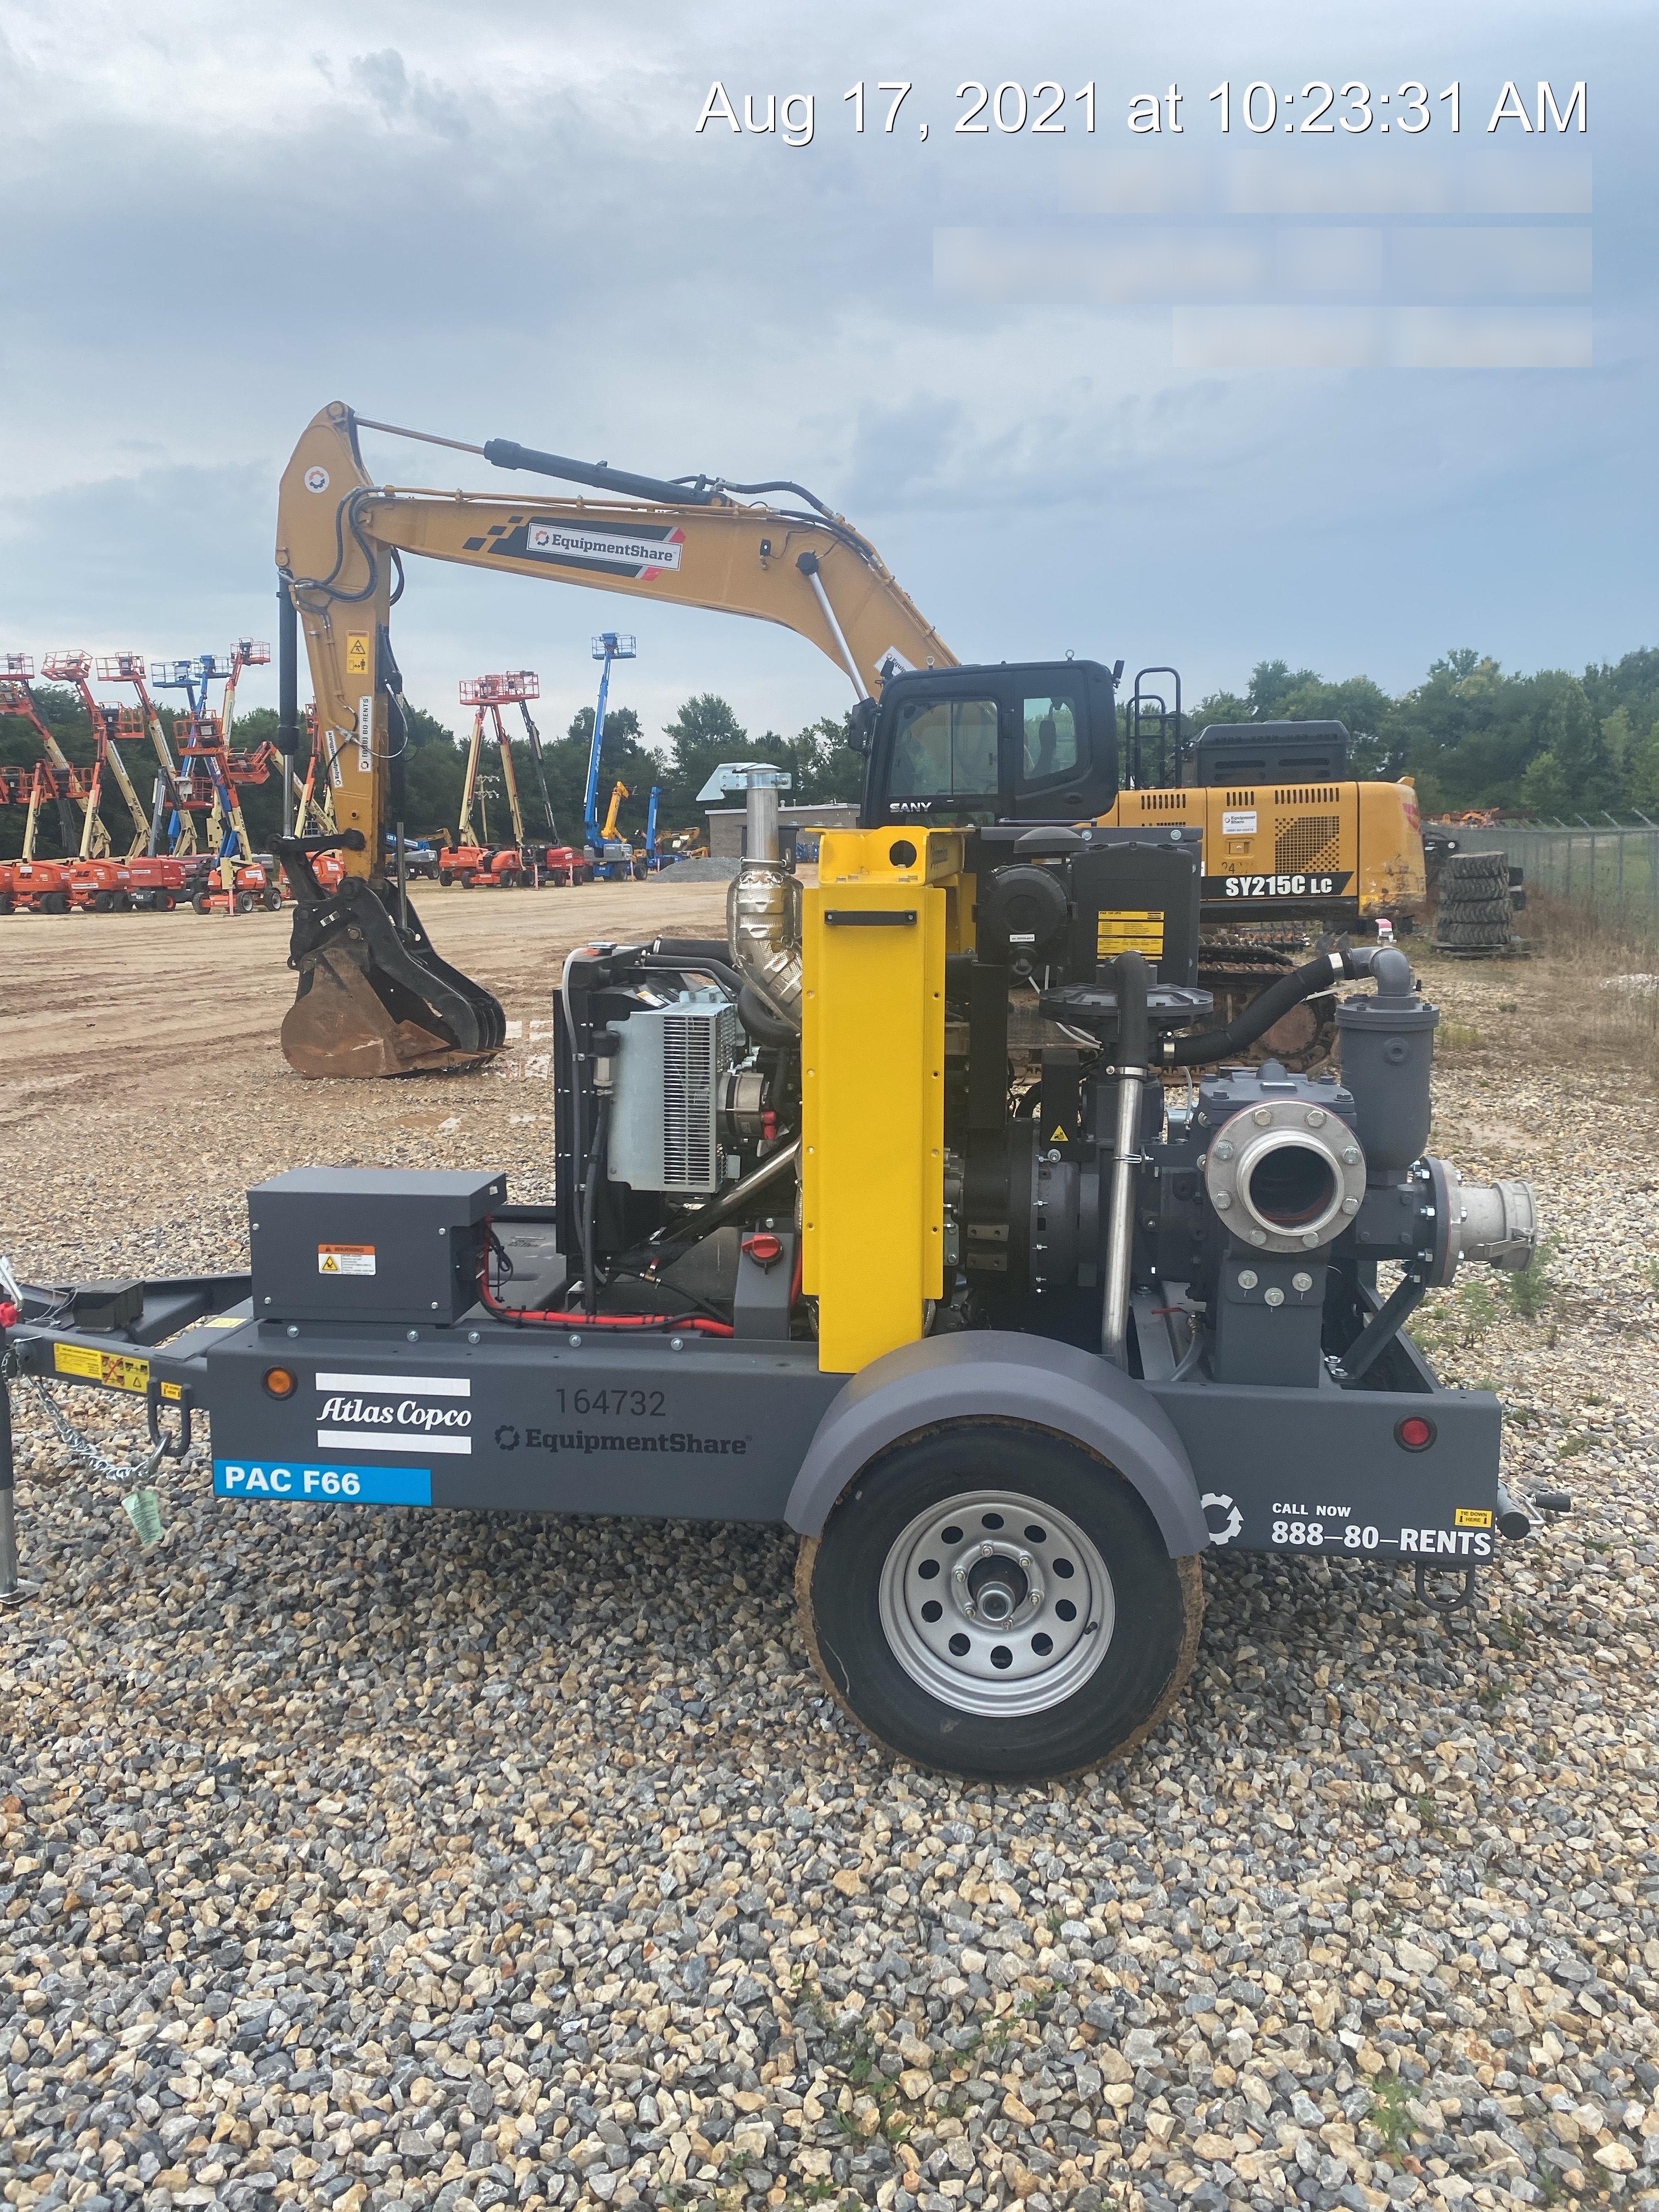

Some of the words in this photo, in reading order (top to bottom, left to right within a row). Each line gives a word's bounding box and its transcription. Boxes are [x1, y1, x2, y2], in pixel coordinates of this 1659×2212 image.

[552, 534, 673, 561] EquipmentShare
[890, 802, 932, 813] SANY
[1226, 875, 1306, 896] SY215C
[1311, 878, 1333, 894] LC
[316, 1397, 394, 1423] Atlas
[397, 1400, 472, 1430] Copco
[556, 1389, 666, 1417] 164732
[225, 1466, 291, 1492] PAC
[303, 1470, 360, 1496] F66
[1272, 1503, 1308, 1515] CALL
[1316, 1505, 1351, 1517] NOW
